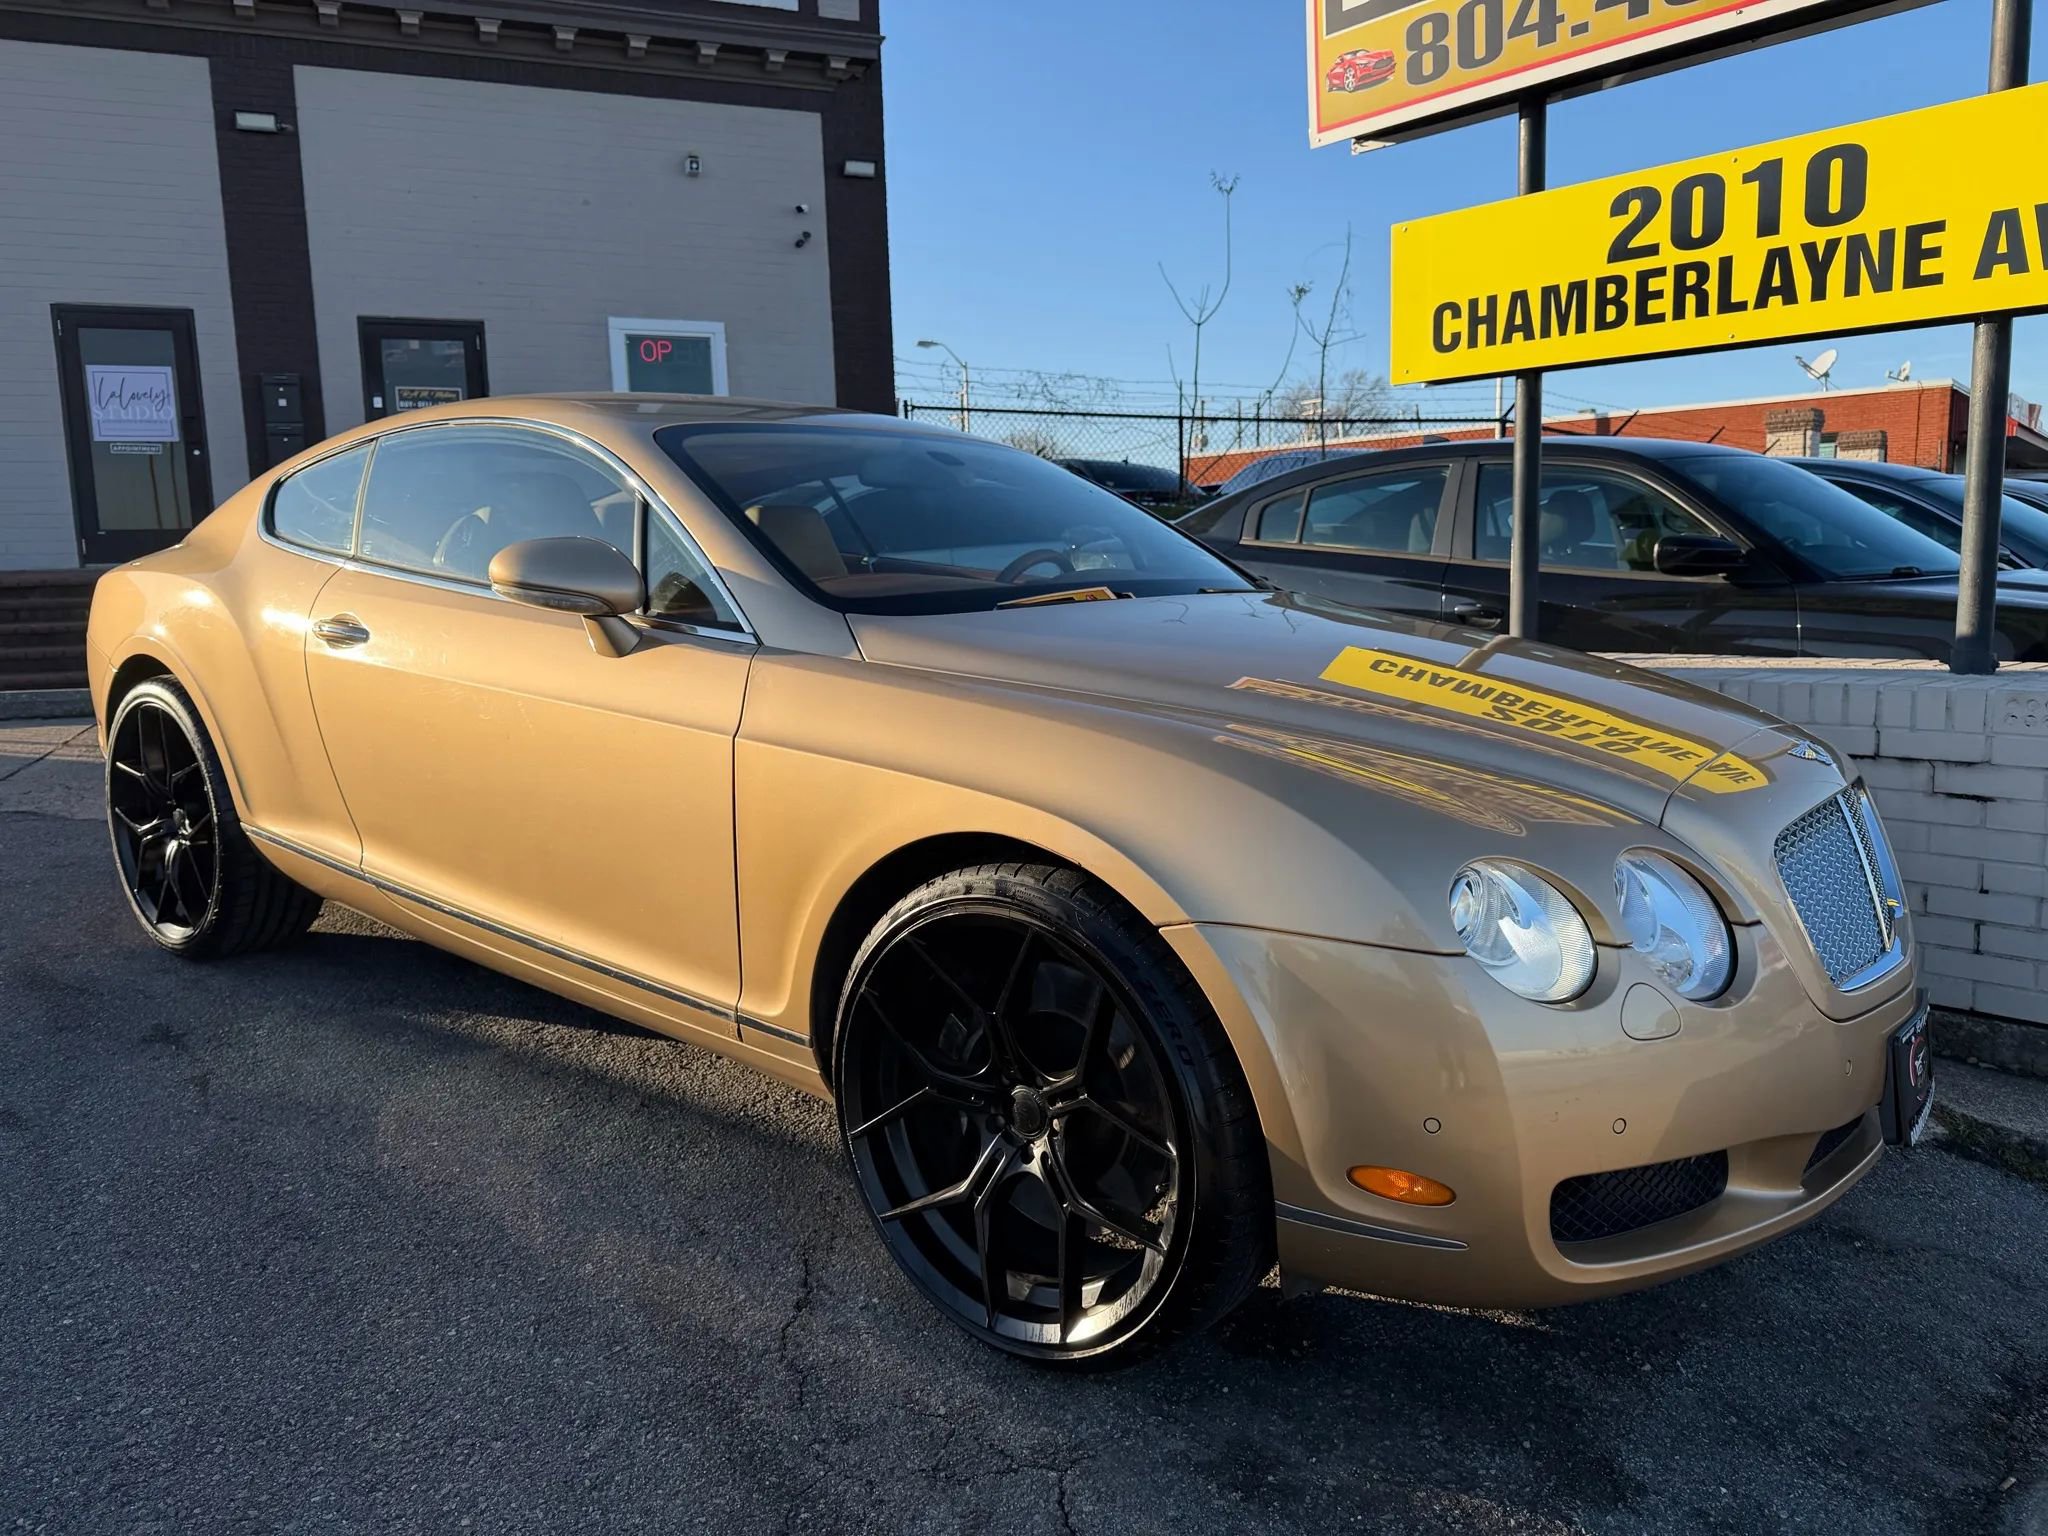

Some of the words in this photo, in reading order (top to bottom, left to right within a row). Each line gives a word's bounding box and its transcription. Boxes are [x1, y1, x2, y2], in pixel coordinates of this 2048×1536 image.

[1405, 0, 1715, 86] 804.
[1607, 143, 1868, 264] 2010
[1432, 219, 1947, 354] CHAMBERLAYNE
[1972, 202, 2048, 281] A
[93, 405, 174, 420] STUDIO
